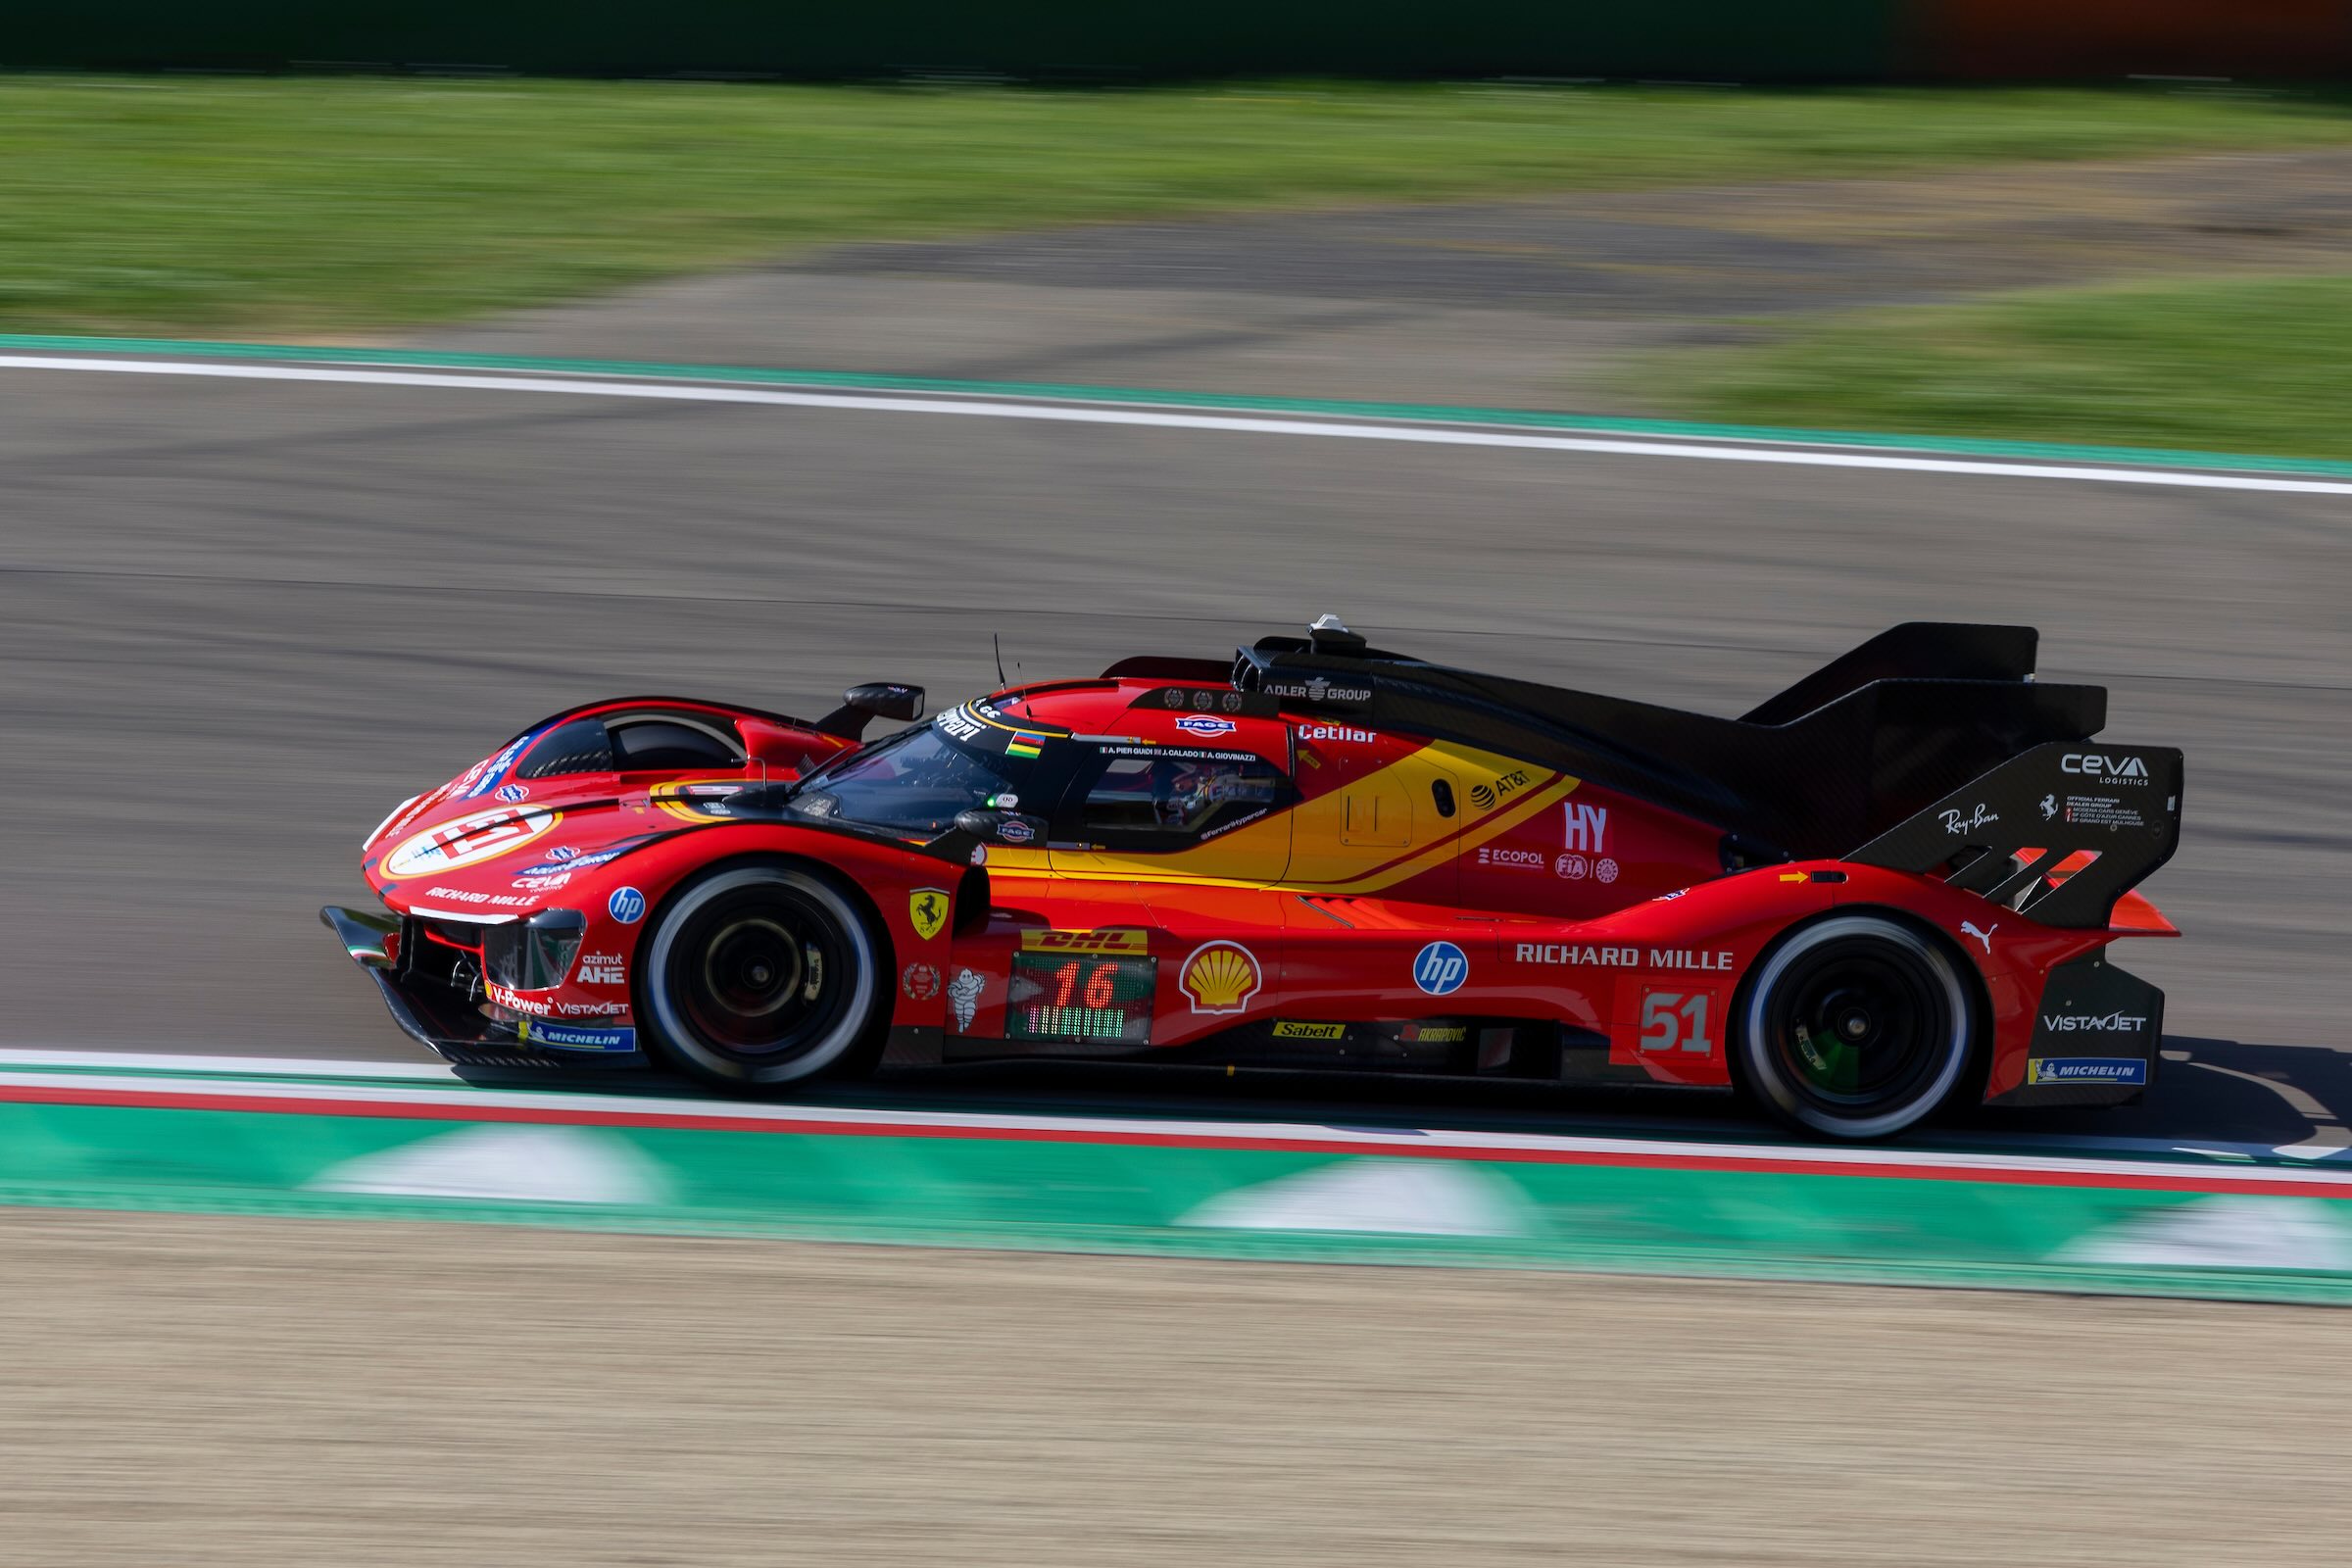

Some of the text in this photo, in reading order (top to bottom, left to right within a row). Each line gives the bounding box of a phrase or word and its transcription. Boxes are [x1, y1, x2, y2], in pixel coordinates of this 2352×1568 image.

[1264, 684, 1371, 702] ADLER GROUP
[1298, 724, 1377, 743] Cetilar
[1215, 753, 1256, 761] GIOVINAZZI
[1494, 770, 1532, 797] AT&T
[2099, 776, 2149, 786] LOGISTICS
[1563, 802, 1607, 853] HY
[1938, 803, 1999, 835] Ray-Ban
[1493, 849, 1544, 864] ECOPOL
[1557, 858, 1584, 874] FIA
[424, 886, 540, 906] RICHARD MILLE
[614, 887, 641, 923] hp
[1038, 931, 1130, 949] DHL
[582, 950, 623, 965] azimut
[1516, 943, 1734, 971] RICHARD MILLE
[1420, 943, 1463, 994] hp
[1055, 960, 1119, 1009] 16
[492, 985, 552, 1015] V-Power
[1640, 992, 1712, 1053] 51
[2043, 1009, 2146, 1031] VISTAJET
[548, 1032, 620, 1045] MICHELIN
[1281, 1024, 1338, 1038] Sabelt
[2059, 1065, 2134, 1076] MICHELIN
